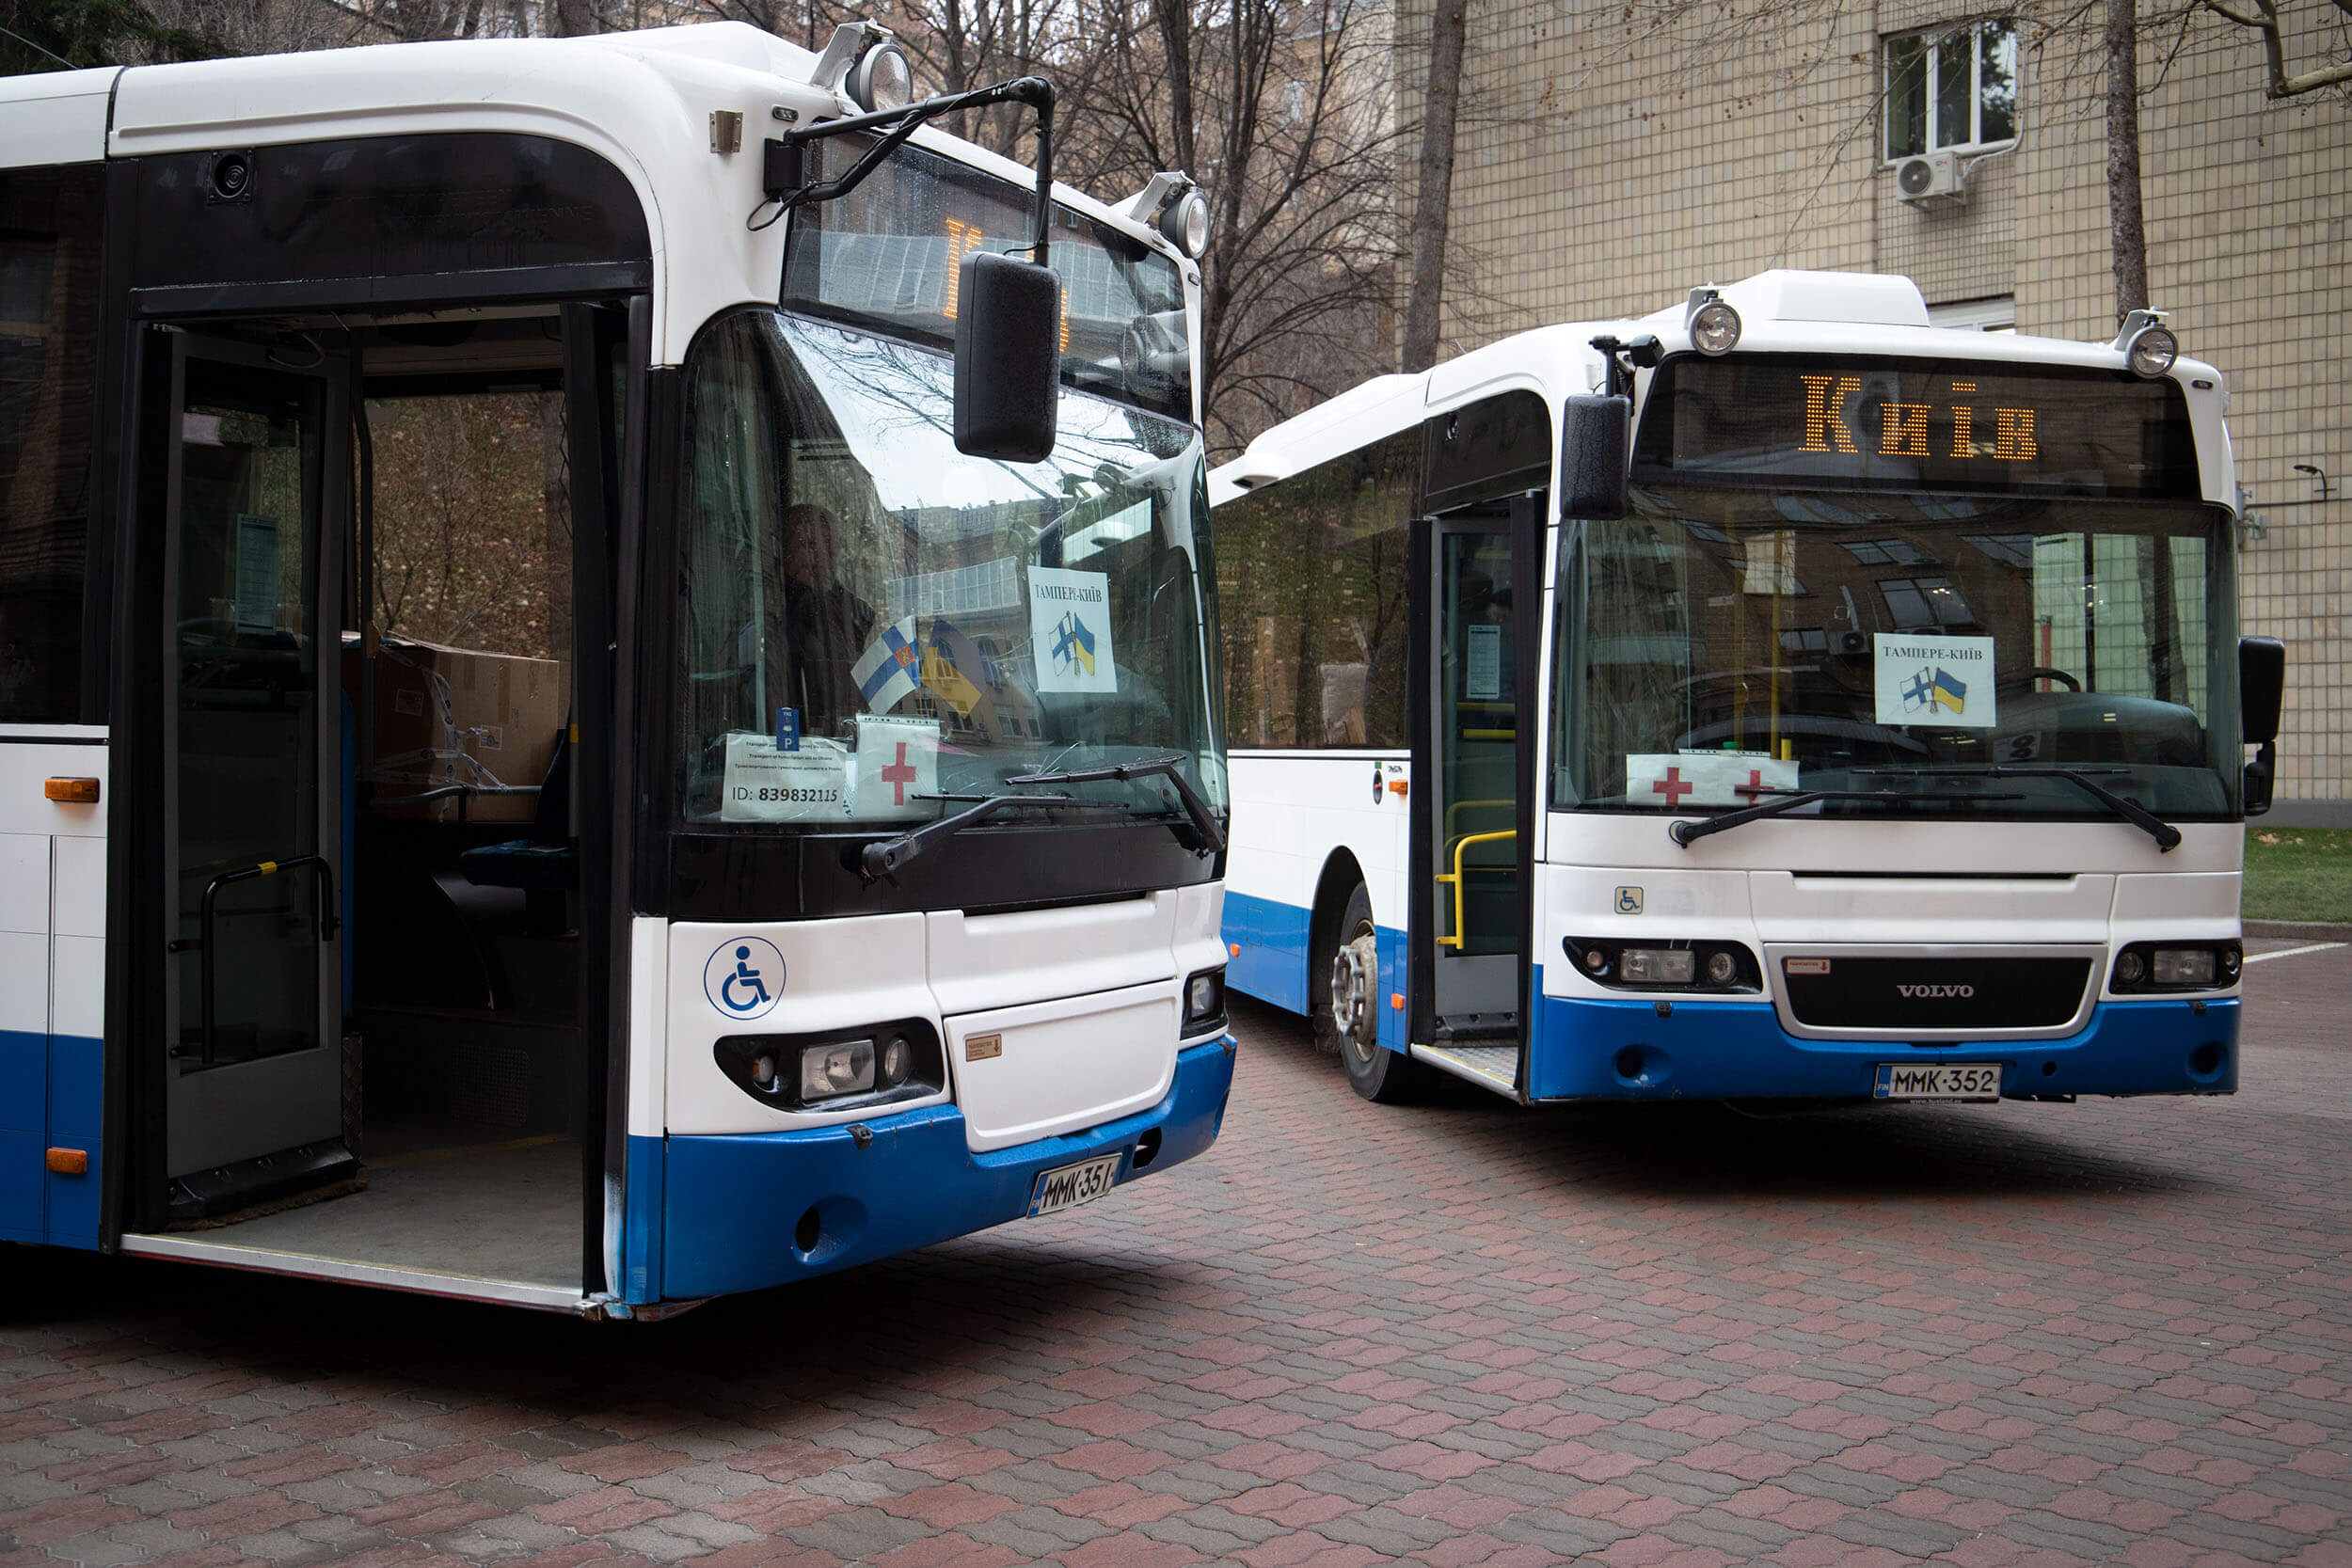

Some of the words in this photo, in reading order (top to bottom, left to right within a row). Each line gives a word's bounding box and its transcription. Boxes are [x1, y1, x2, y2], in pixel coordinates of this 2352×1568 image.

[1798, 375, 2037, 460] Київ
[1035, 584, 1103, 602] ТАМПЕРЕ-КИЇВ
[1883, 646, 1983, 660] ТАМПЕРЕ-КИЇВ
[732, 787, 754, 801] ID:
[758, 788, 838, 802] 839832115
[1896, 985, 1974, 998] VOLVO
[1894, 1069, 1994, 1092] MMK-352
